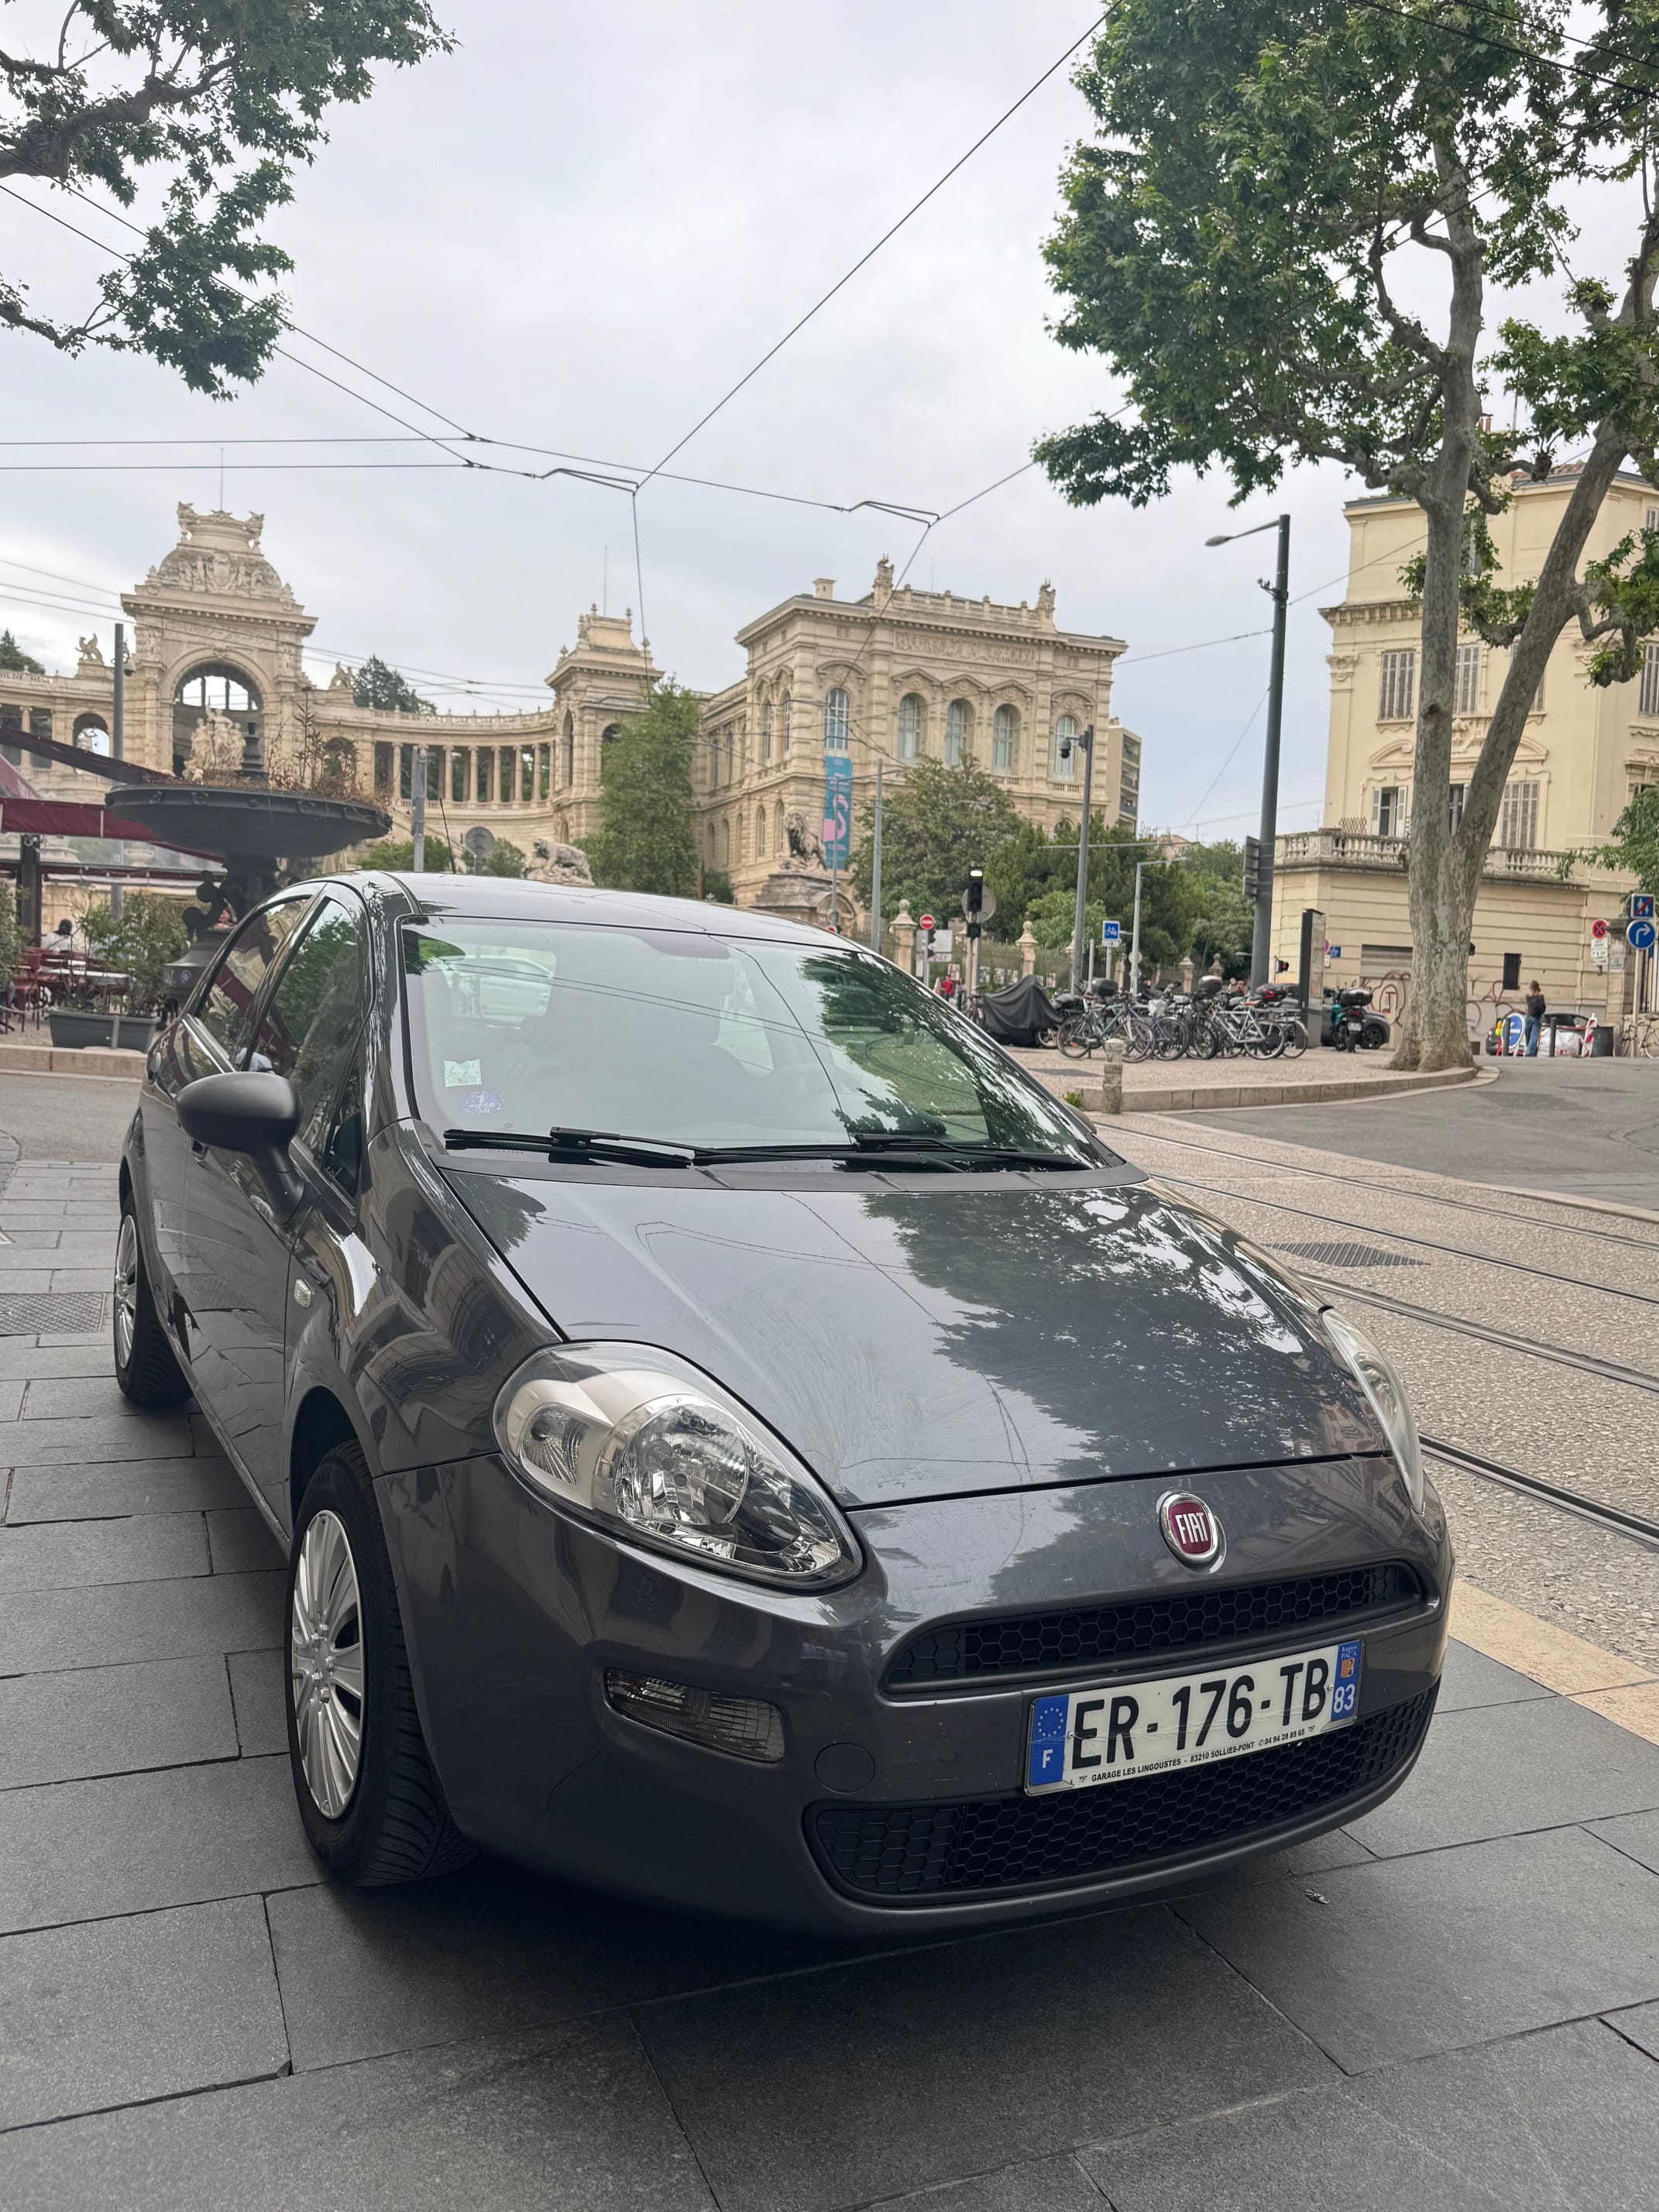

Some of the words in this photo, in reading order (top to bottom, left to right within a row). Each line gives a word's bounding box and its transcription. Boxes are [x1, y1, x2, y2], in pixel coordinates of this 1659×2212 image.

[1175, 1512, 1208, 1544] FIAT
[1341, 1650, 1357, 1660] PACA
[1334, 1684, 1355, 1713] 83
[1072, 1658, 1329, 1770] ER-176-TB
[1042, 1749, 1053, 1769] F
[1091, 1769, 1121, 1781] GARAGE
[1122, 1767, 1136, 1776] LES
[1137, 1758, 1181, 1773] LINGOUSTES
[1190, 1752, 1210, 1763] 83210
[1211, 1741, 1255, 1758] SOLLIES-PONT
[1298, 1728, 1306, 1736] 65
